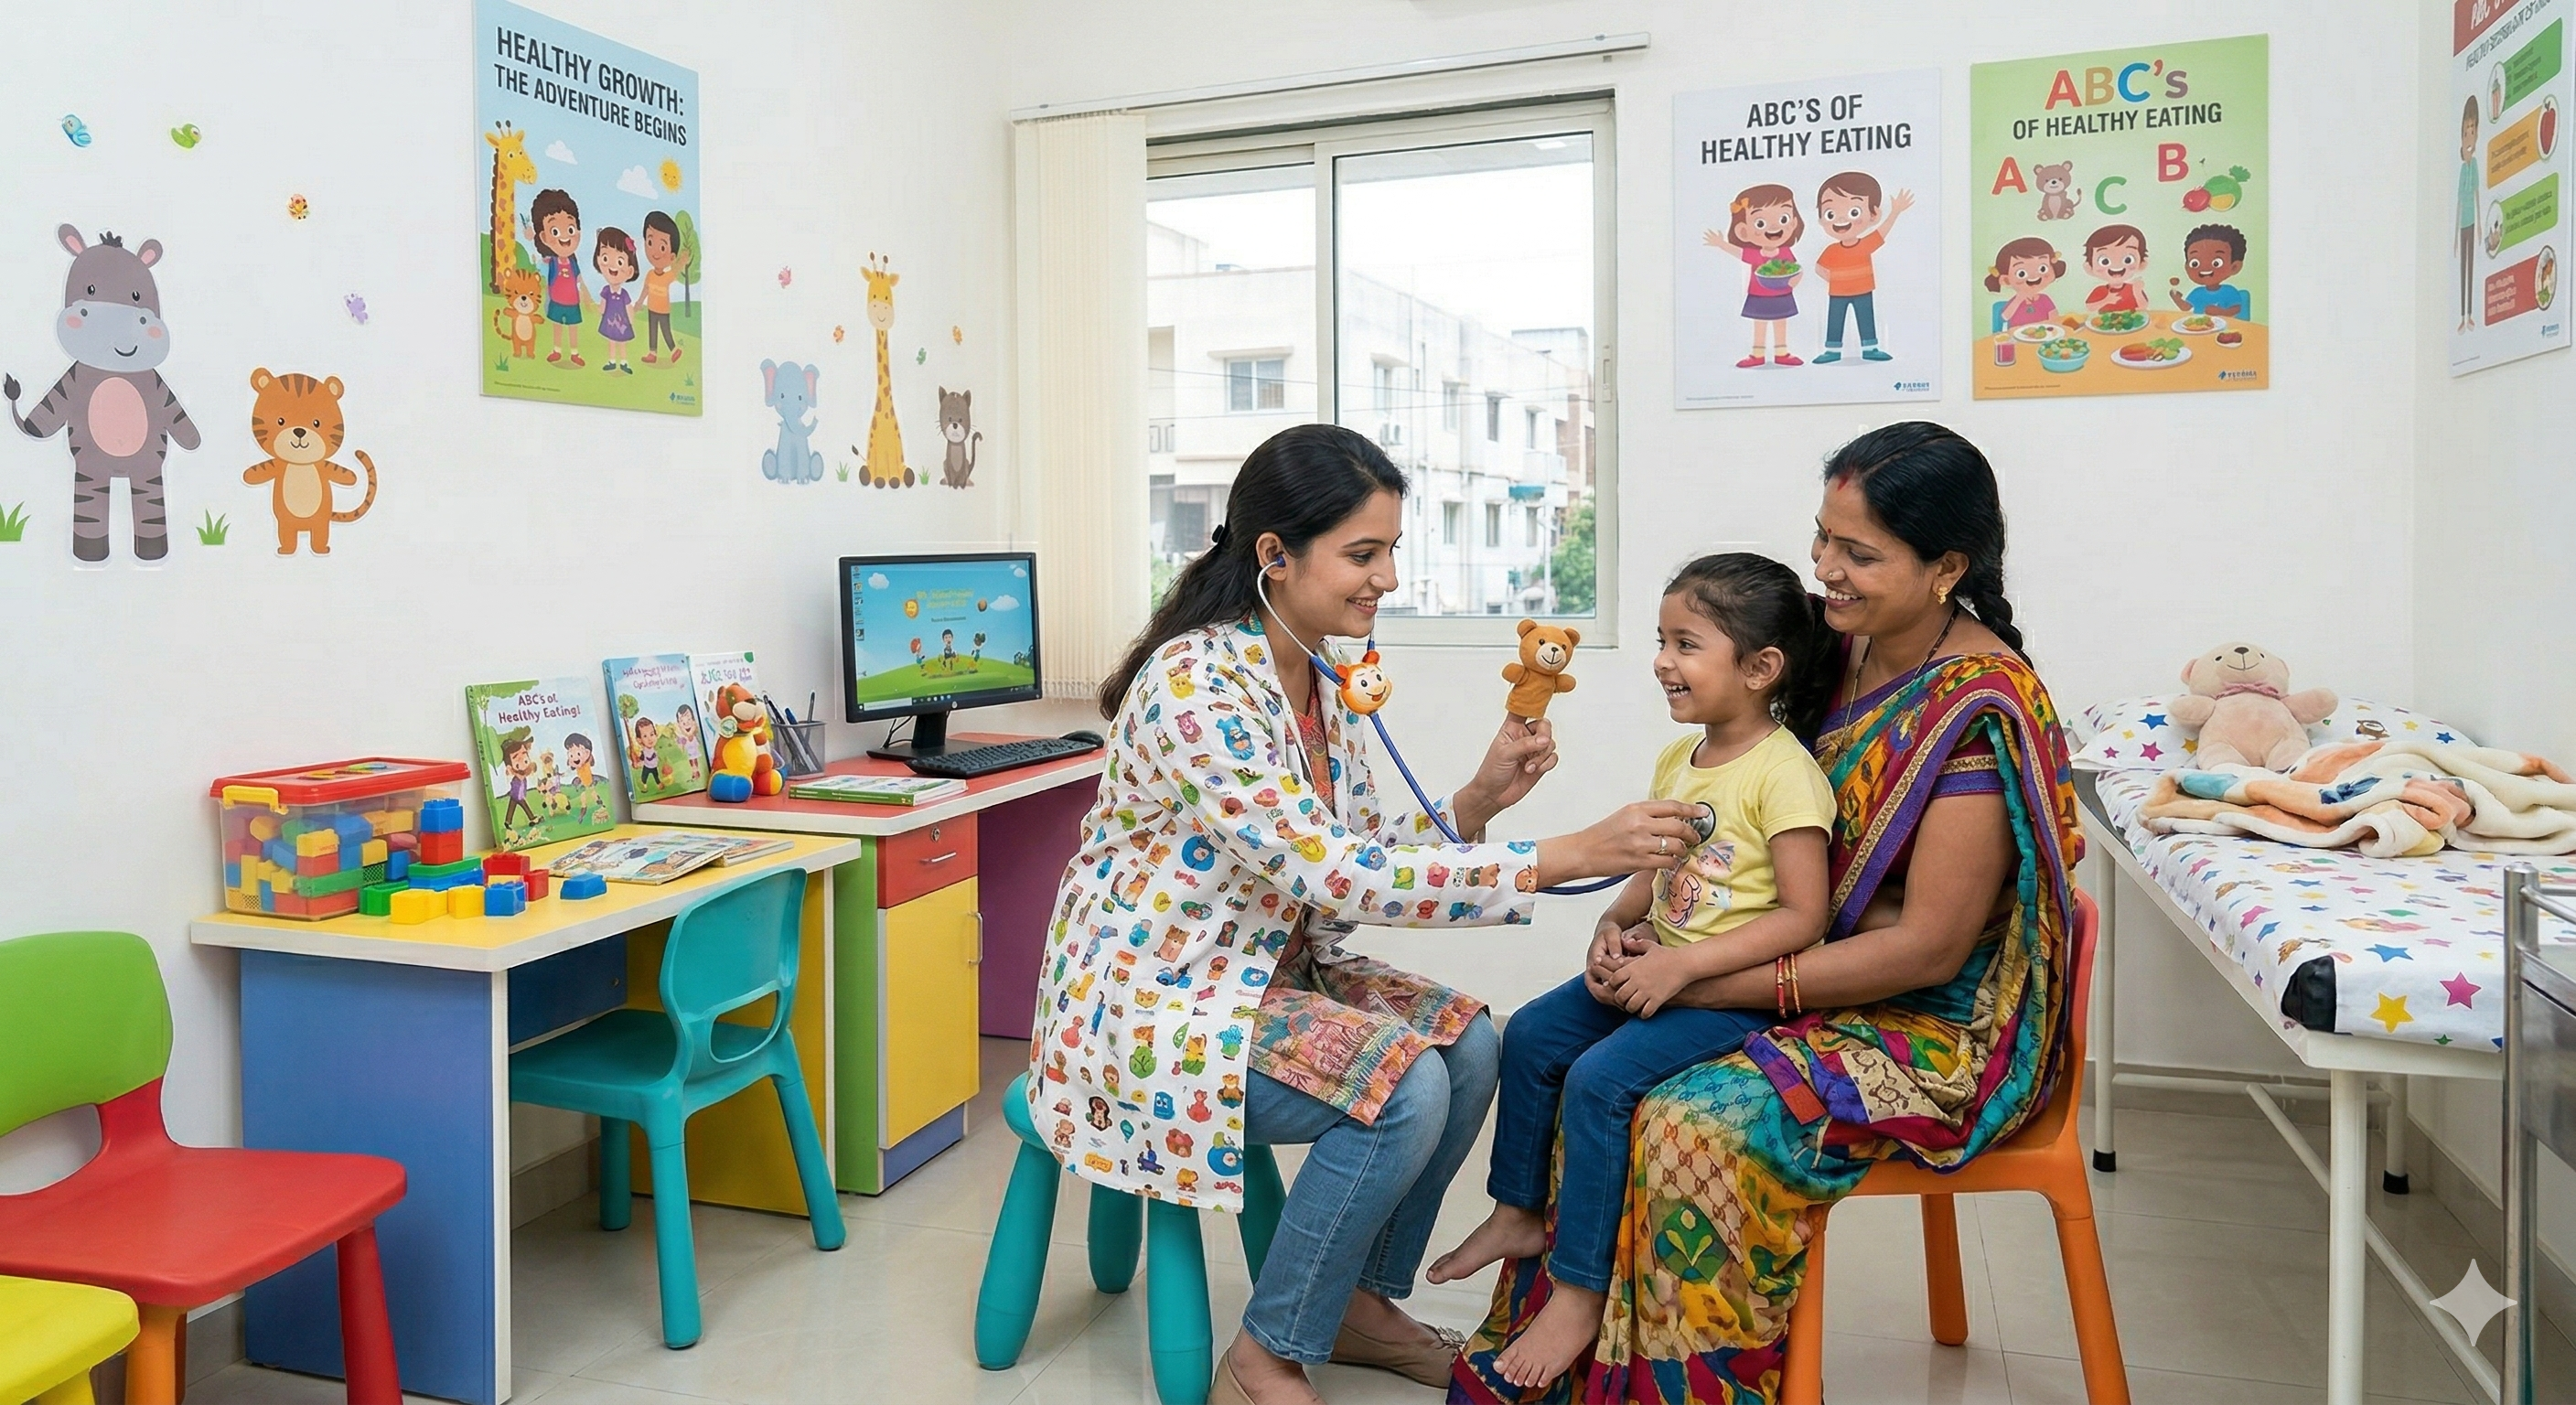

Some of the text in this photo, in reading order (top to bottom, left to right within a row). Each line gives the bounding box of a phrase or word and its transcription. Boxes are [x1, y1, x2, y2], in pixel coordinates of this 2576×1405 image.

[497, 26, 684, 116] HEALTHY GROWTH:
[2045, 59, 2189, 111] ABC’s
[494, 63, 687, 146] THE ADVENTURE BEGINS
[1746, 93, 1862, 129] ABC’S OF
[2012, 102, 2223, 140] OF HEALTHY EATING
[1701, 123, 1912, 165] HEALTHY EATING
[2157, 143, 2189, 183] B
[1991, 156, 2027, 195] A
[2094, 176, 2128, 215] C
[499, 709, 541, 724] Healthy
[518, 692, 546, 706] ABC's
